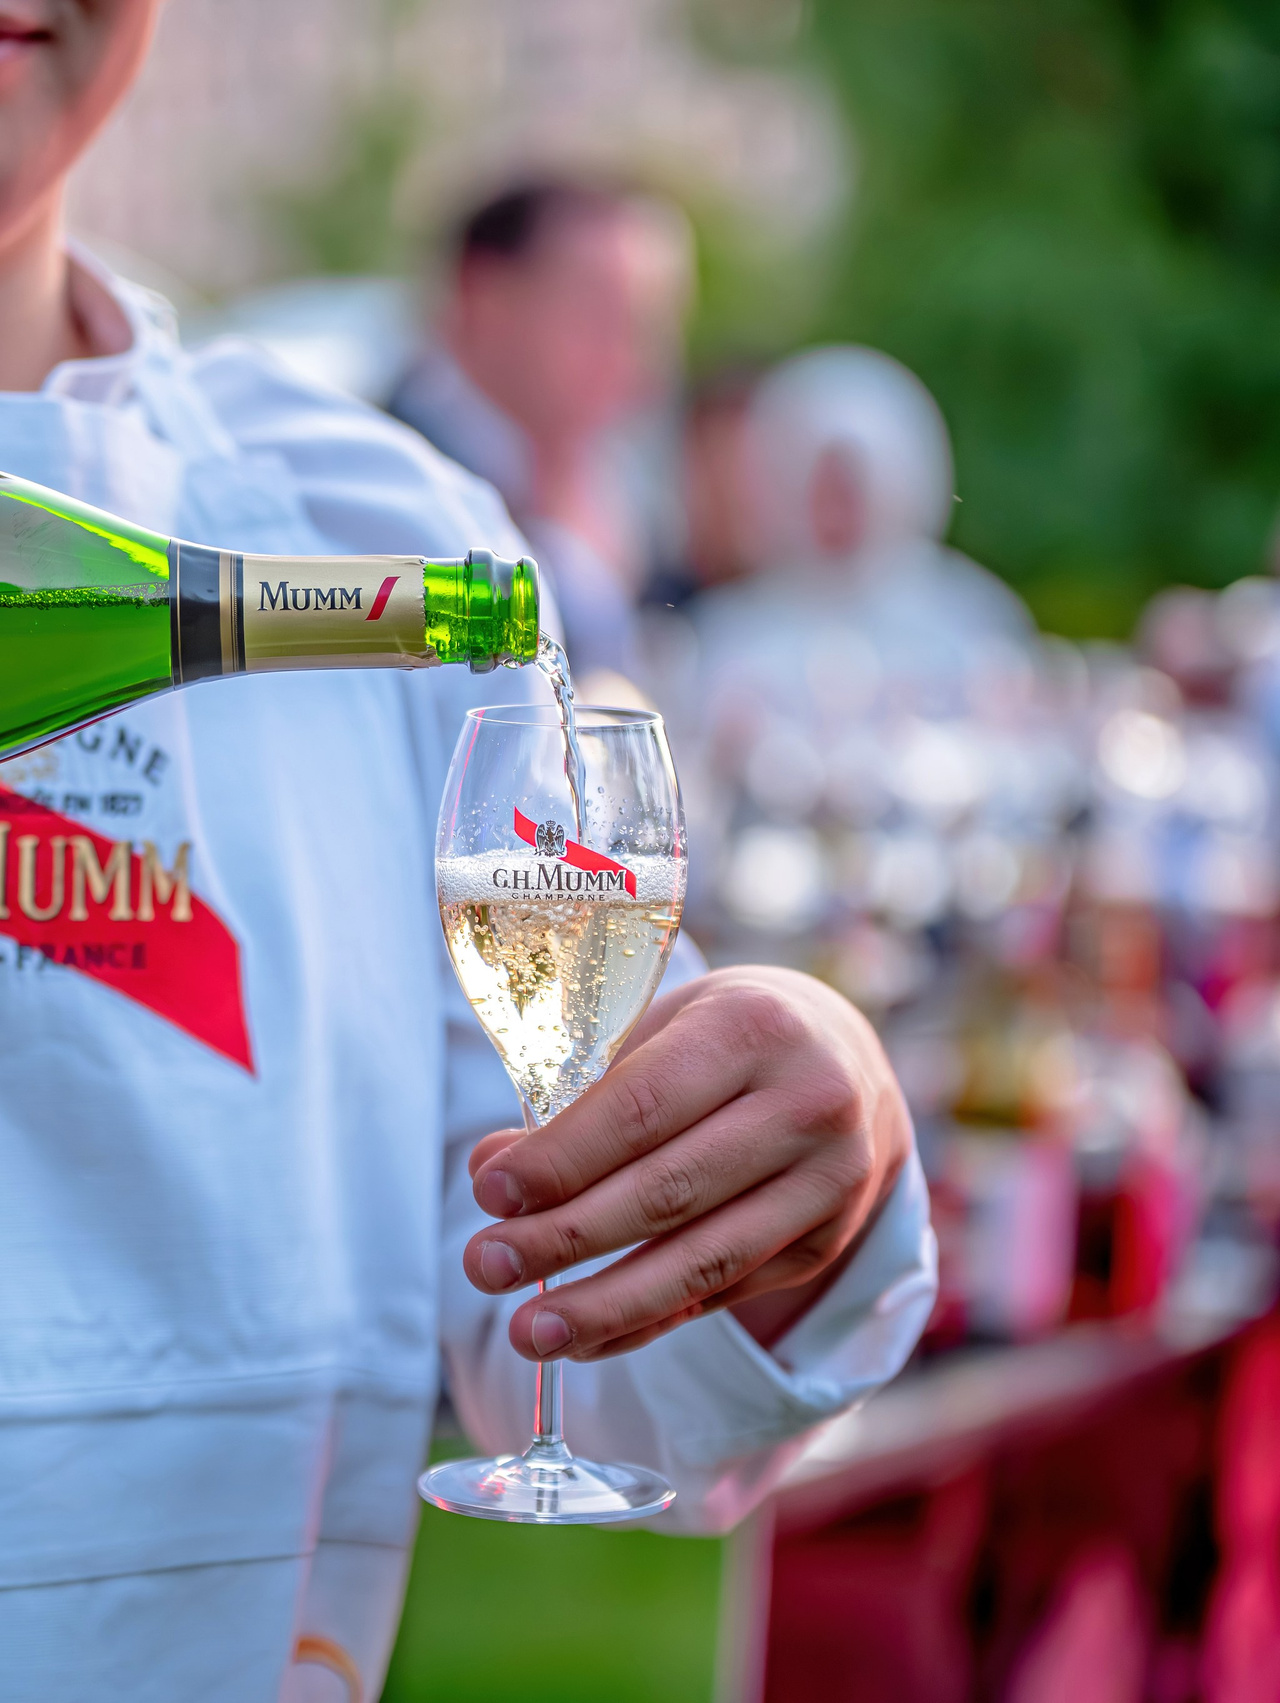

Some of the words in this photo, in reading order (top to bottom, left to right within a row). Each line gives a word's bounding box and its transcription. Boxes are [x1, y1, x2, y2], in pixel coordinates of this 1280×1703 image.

[257, 581, 363, 611] MUMM
[511, 892, 606, 902] CHAMPAGNE
[16, 942, 147, 970] FRANCE
